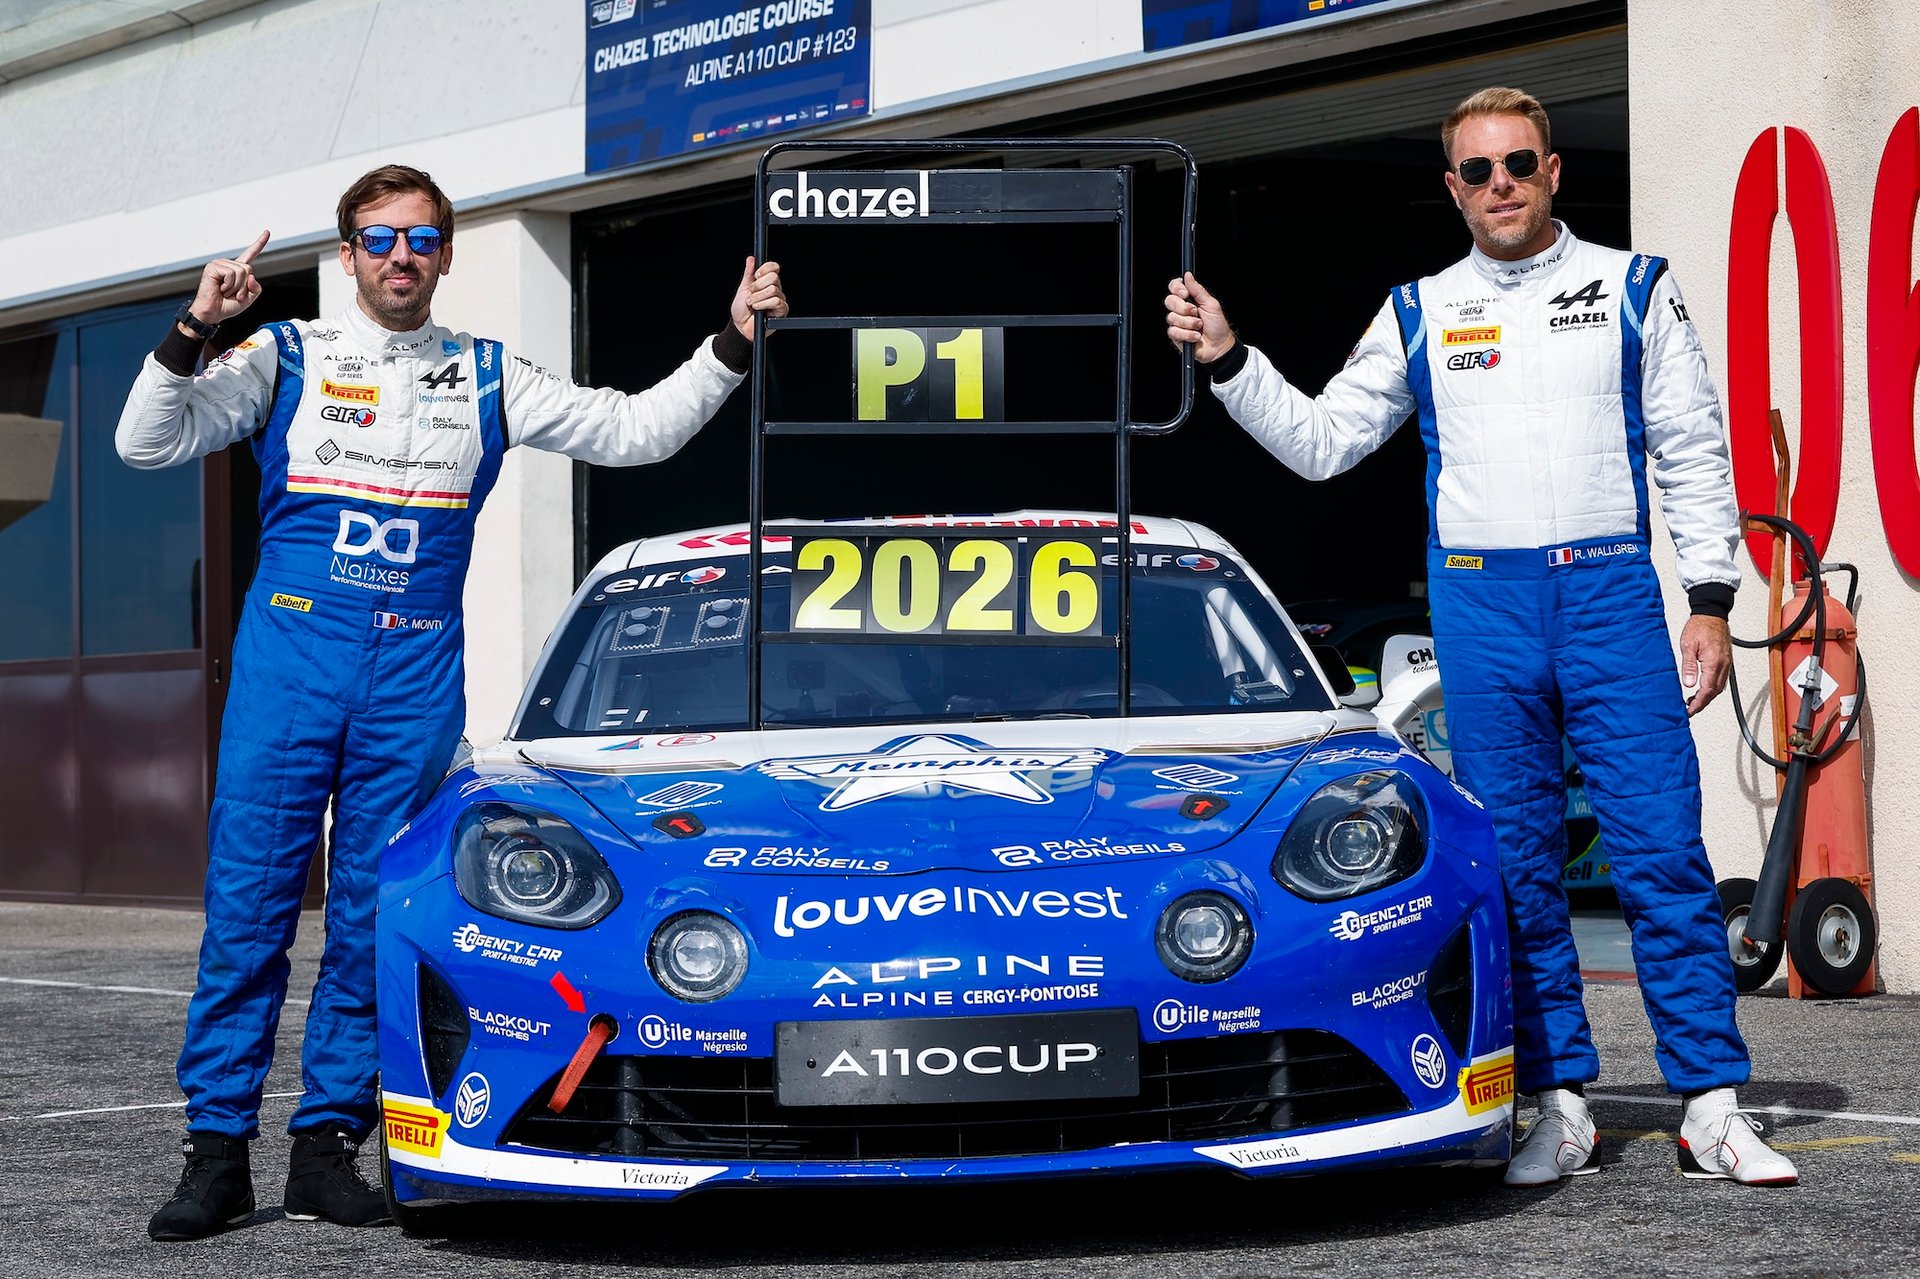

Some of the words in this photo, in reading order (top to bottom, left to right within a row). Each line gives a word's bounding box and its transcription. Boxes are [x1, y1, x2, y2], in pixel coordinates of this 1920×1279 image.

[594, 37, 649, 73] CHAZEL
[652, 7, 761, 58] TECHNOLOGIE
[763, 0, 834, 30] COURSE
[684, 54, 734, 87] ALPINE
[734, 45, 776, 76] A110
[777, 37, 810, 66] CUP
[813, 26, 857, 57] #123
[768, 170, 929, 219] chazel
[1507, 253, 1563, 277] ALPINE
[1632, 255, 1652, 286] Sabelt
[1445, 297, 1500, 308] ALPINE
[1550, 312, 1609, 328] CHAZEL
[390, 334, 434, 352] ALPINE
[1446, 328, 1497, 343] PIRELLI
[323, 354, 379, 367] ALPINE
[1447, 351, 1484, 371] elf
[857, 328, 985, 421] P1
[325, 382, 375, 401] PIRELLI
[418, 393, 470, 403] louveinvest
[321, 405, 358, 424] elf
[432, 416, 452, 424] RALY
[1574, 549, 1586, 560] R.
[1587, 543, 1639, 559] WALLGREN
[1449, 556, 1481, 569] Sabelt
[603, 569, 684, 594] elf
[795, 537, 1099, 634] 2026
[274, 594, 309, 611] Sabelt
[398, 618, 408, 629] R.
[830, 755, 1046, 775] Memphis
[756, 847, 829, 857] RALY
[1040, 836, 1109, 852] RALY
[1050, 842, 1186, 862] CONSEILS
[750, 857, 890, 872] CONSEILS
[773, 885, 1128, 938] louveinvest
[1350, 903, 1405, 931] AGENCY
[1408, 895, 1433, 913] CAR
[1373, 921, 1393, 935] SPORT
[1392, 920, 1397, 929] &
[1397, 912, 1422, 928] PRESTIGE
[466, 932, 525, 954] AGENCY
[526, 944, 563, 962] CAR
[481, 949, 502, 960] SPORT
[501, 953, 508, 962] &
[507, 954, 539, 968] PRESTIGE
[811, 955, 1105, 989] ALPINE
[812, 990, 953, 1008] ALPINE
[963, 983, 1099, 1005] CERGY-PONTOISE
[1351, 970, 1428, 1007] BLACKOUT
[1372, 989, 1414, 1010] WATCHES
[468, 1006, 551, 1036] BLACKOUT
[1156, 1001, 1209, 1030] Utile
[1212, 1006, 1261, 1022] Marseille
[485, 1023, 530, 1041] WATCHES
[641, 1017, 692, 1046] Utile
[695, 1029, 748, 1041] Marseille
[1217, 1018, 1261, 1034] Négresko
[703, 1041, 748, 1054] Négresko
[820, 1042, 1100, 1077] A110CUP
[1228, 1142, 1301, 1166] Victoria
[620, 1167, 690, 1187] Victoria
